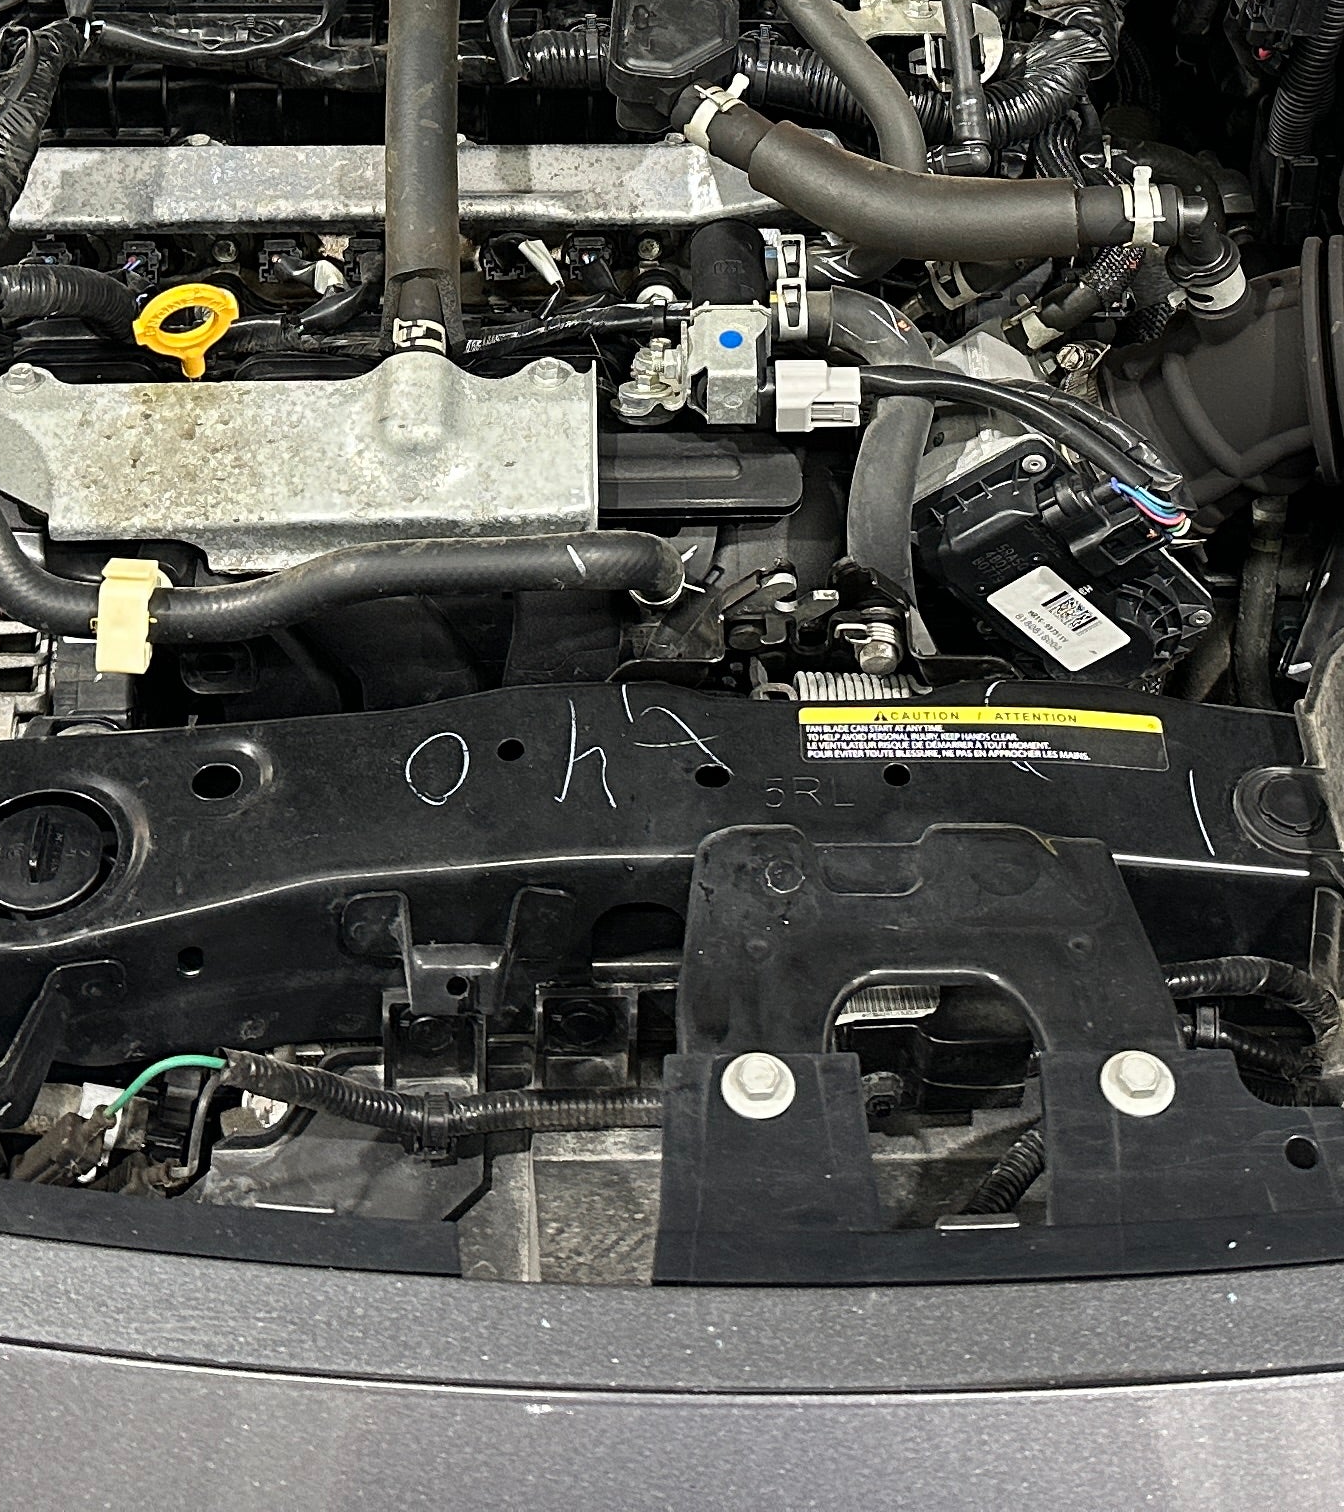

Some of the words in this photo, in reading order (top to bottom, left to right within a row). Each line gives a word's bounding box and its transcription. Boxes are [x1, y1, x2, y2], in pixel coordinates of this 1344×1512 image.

[890, 711, 960, 721] CAUTION
[994, 712, 1077, 723] ATTENTION
[806, 724, 822, 733] FAN
[823, 724, 849, 733] BLADE
[850, 724, 868, 733] CAN
[869, 724, 894, 733] START
[895, 724, 906, 733] AT
[807, 733, 818, 741] TO
[820, 733, 840, 741] HELP
[841, 733, 867, 741] AVOID
[868, 733, 909, 741] PERSONAL
[941, 733, 960, 741] KEEP
[961, 733, 990, 741] HANDS
[807, 741, 818, 749] LE
[818, 741, 877, 749] VENTILATEUR
[878, 741, 911, 749] RISQUE
[912, 741, 924, 749] DE
[983, 741, 1006, 749] TOUT
[1008, 741, 1051, 749] MOMENT.
[807, 749, 833, 758] POUR
[866, 749, 895, 758] TOUTE
[942, 750, 955, 759] NE
[956, 750, 973, 759] PAS
[974, 750, 987, 759] EN
[988, 750, 1041, 759] APPROCHER
[1043, 751, 1058, 760] LES
[1059, 751, 1091, 760] MAINS.
[765, 776, 855, 809] 5RL
